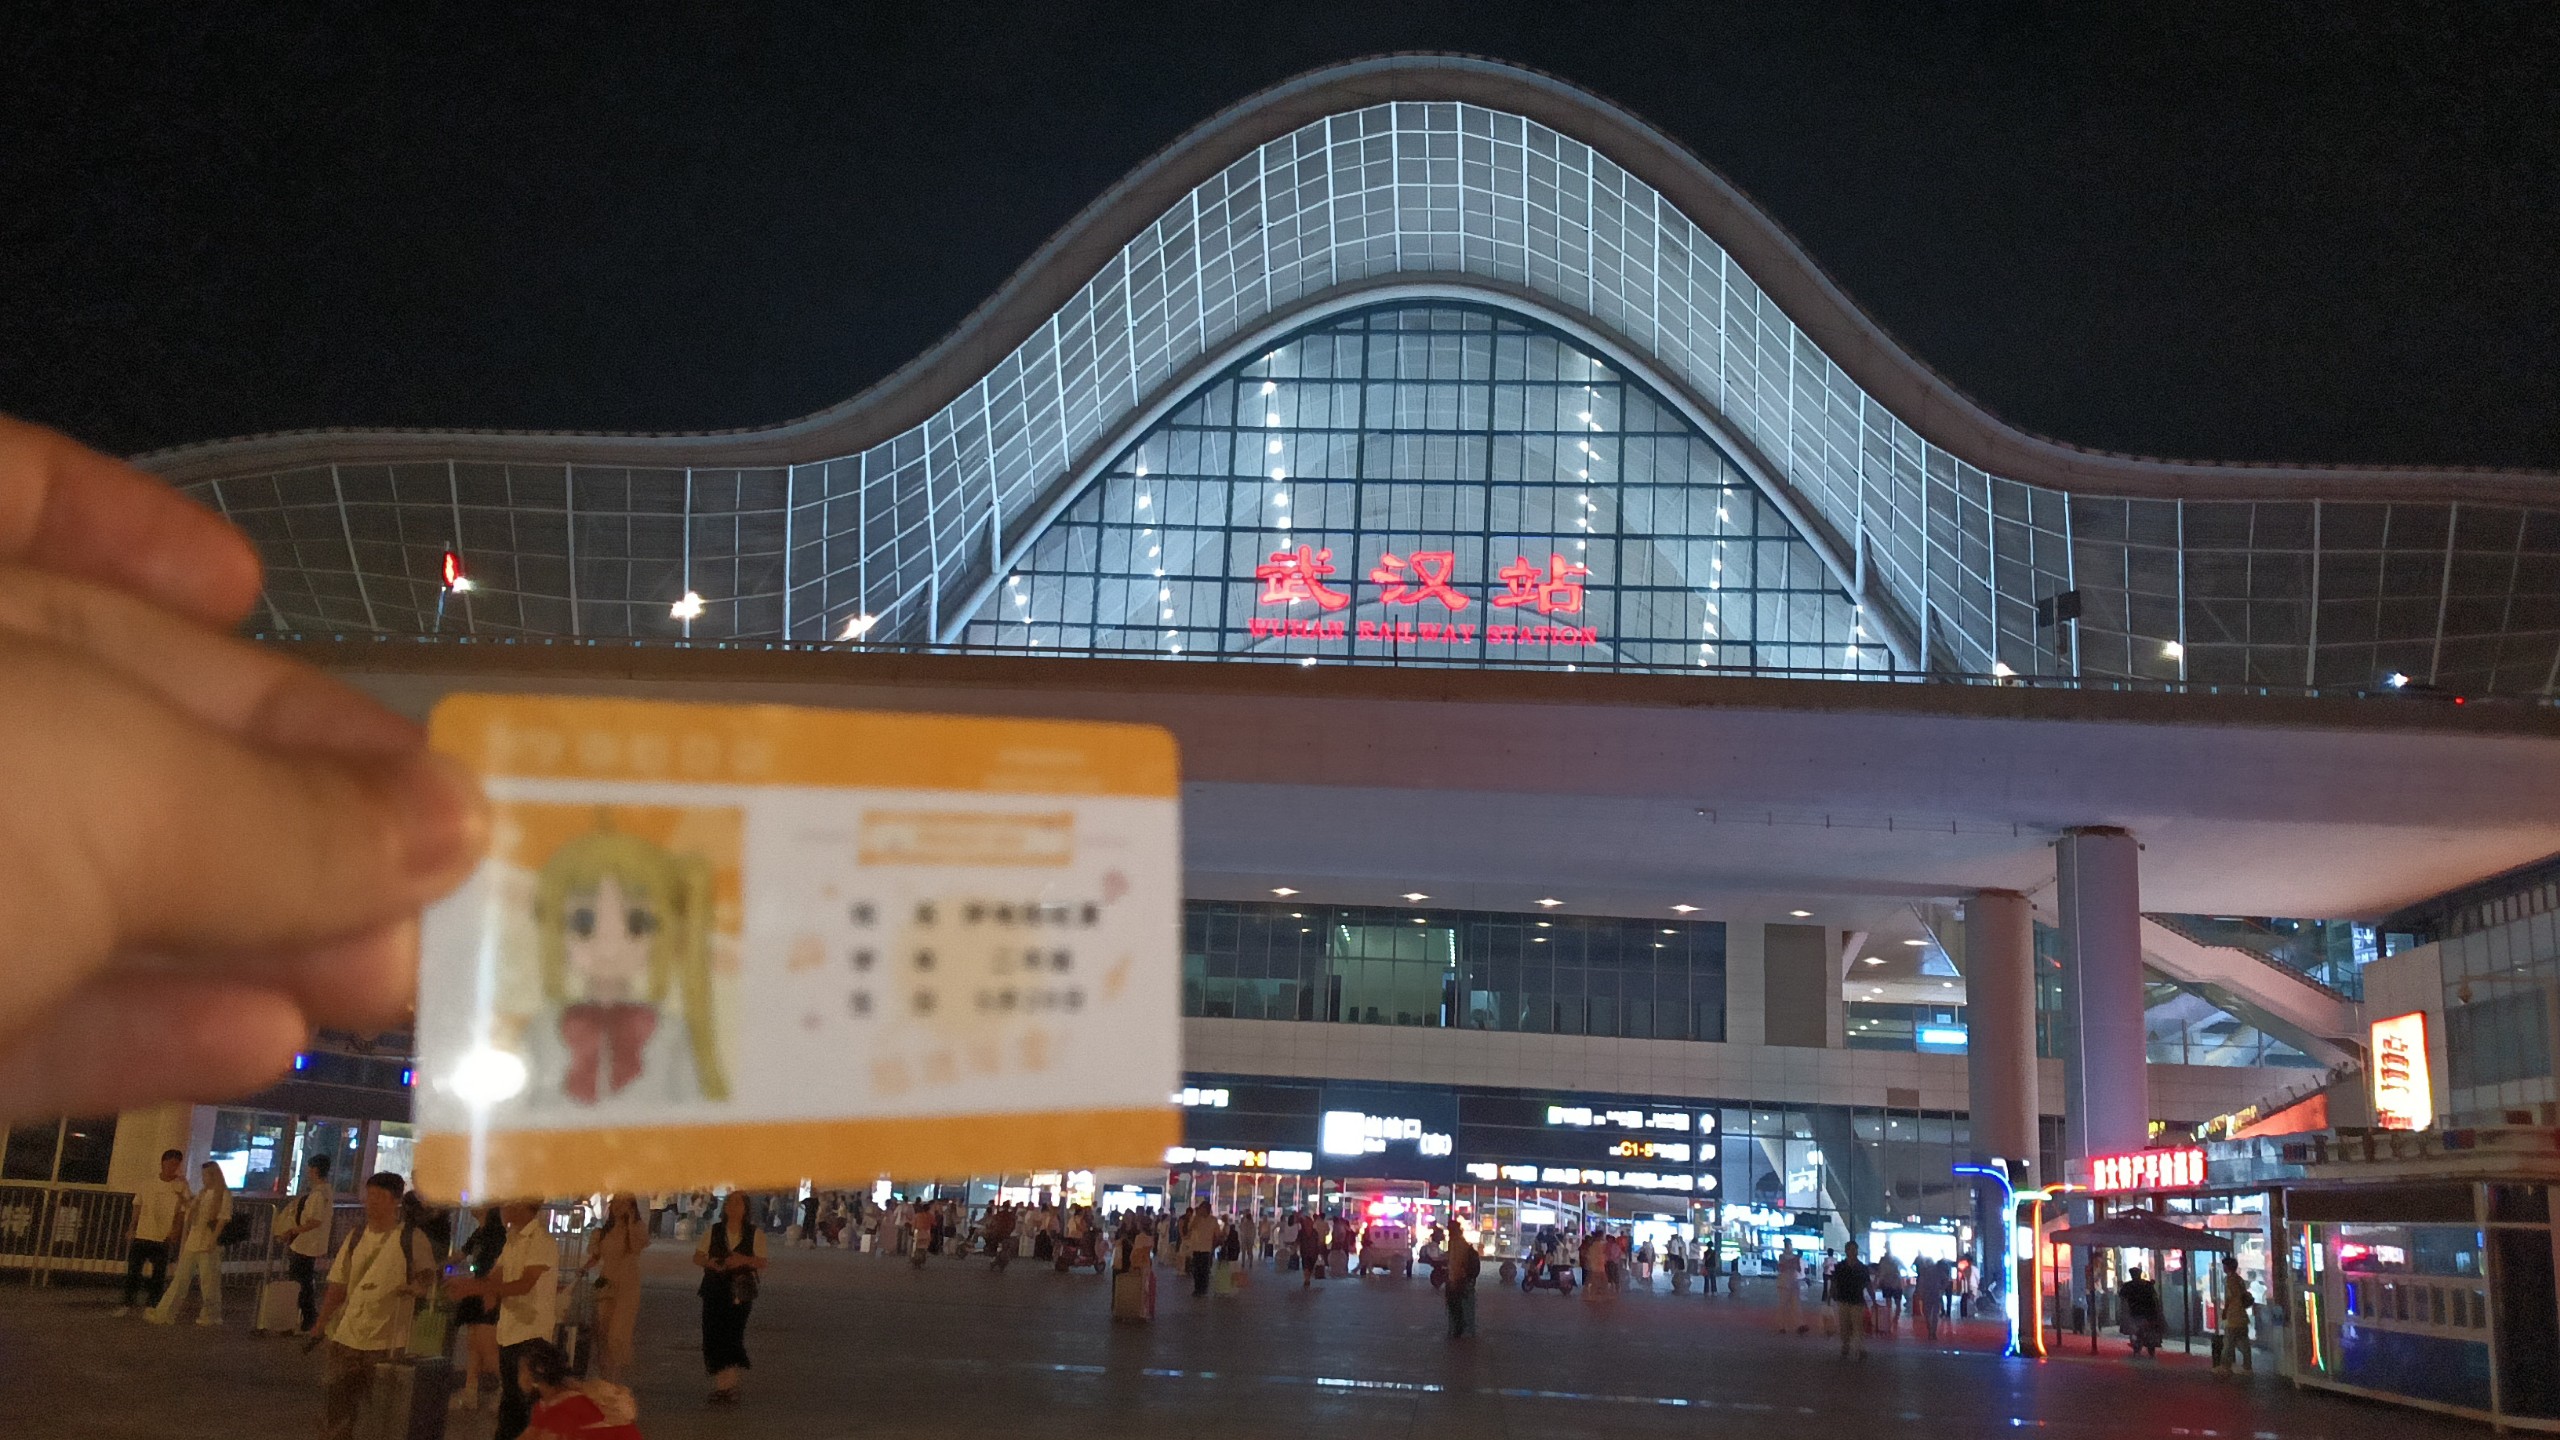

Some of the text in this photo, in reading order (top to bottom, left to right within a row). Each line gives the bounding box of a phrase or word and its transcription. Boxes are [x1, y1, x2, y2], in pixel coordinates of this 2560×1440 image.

[1256, 544, 1592, 614] 武汉站
[1248, 617, 1598, 646] WUHAN RAILWAY STATION
